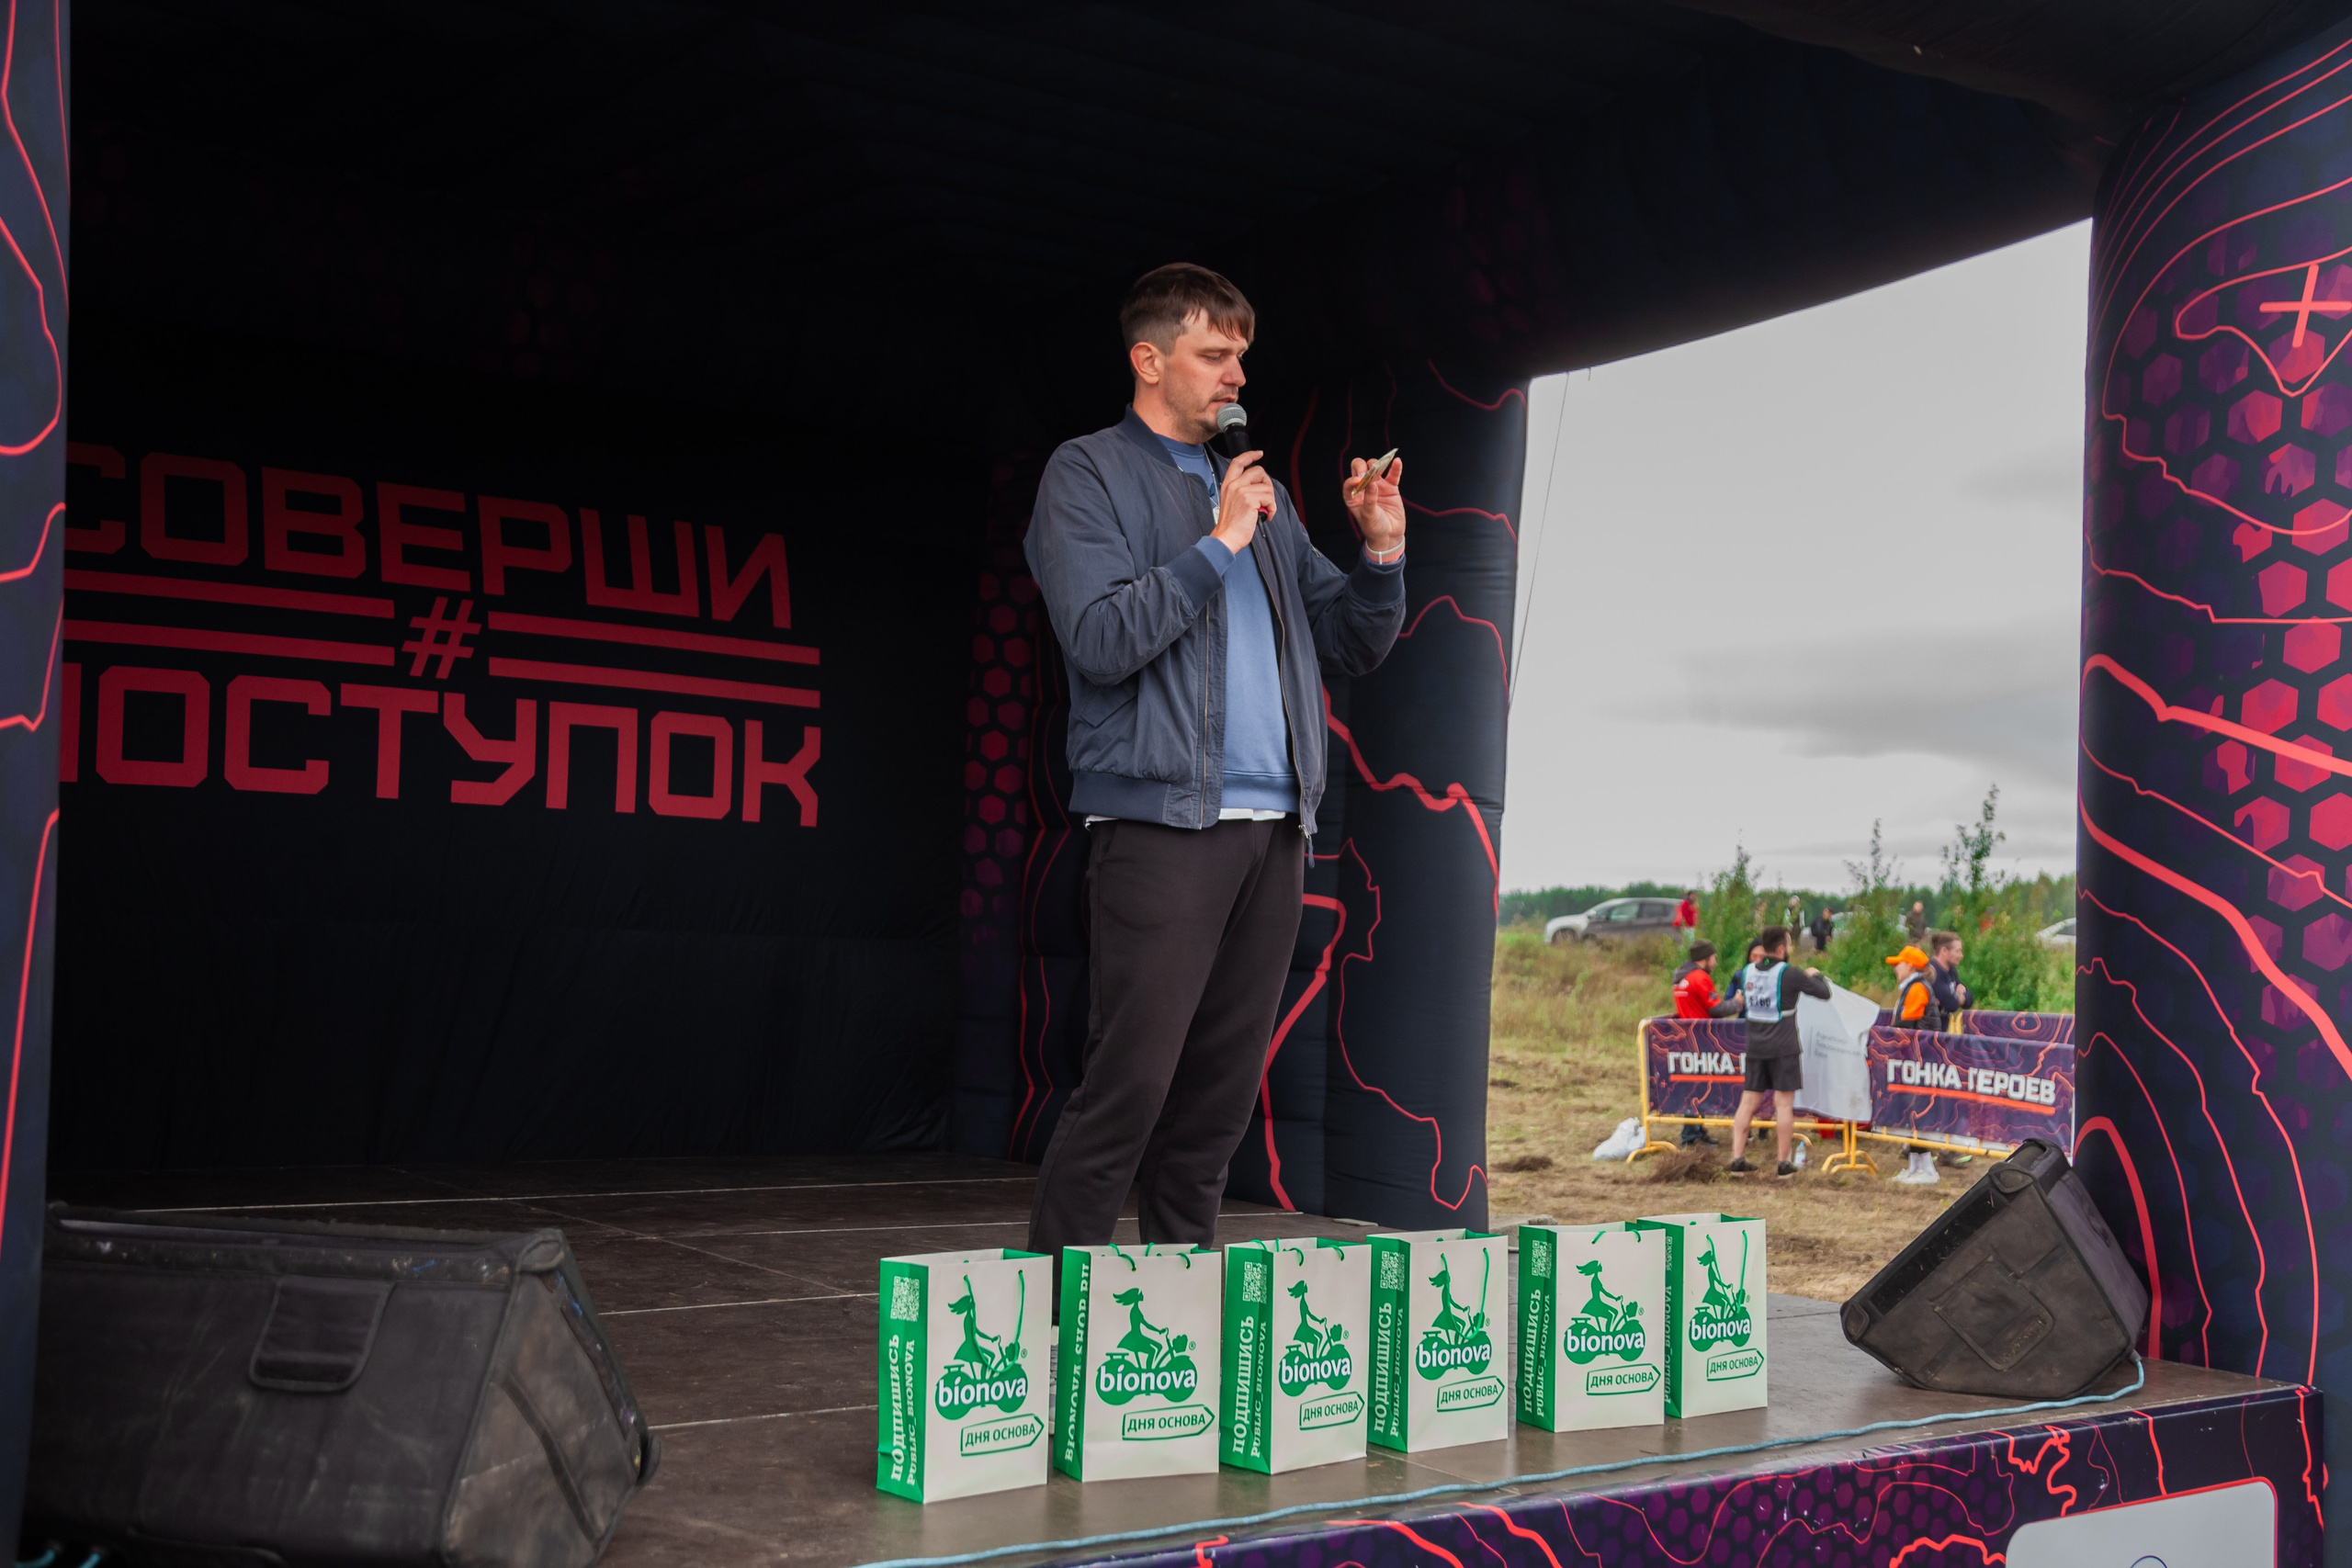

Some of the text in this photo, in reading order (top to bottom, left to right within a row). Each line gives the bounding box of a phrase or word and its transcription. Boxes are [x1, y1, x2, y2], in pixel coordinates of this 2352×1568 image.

[64, 442, 792, 629] СОВЕРШИ
[60, 661, 820, 828] ОСТУПОК
[1668, 1052, 1736, 1075] ГОНКА
[1886, 1059, 2056, 1106] ГОНКА ГЕРОЕВ
[1566, 1327, 1645, 1352] bionova
[1690, 1316, 1751, 1341] bionova
[1419, 1341, 1490, 1369] bionova
[1523, 1289, 1541, 1414] ПОДПИШИСЬ
[1536, 1294, 1550, 1417] PUBLIC_BIONOVA
[1710, 1356, 1758, 1374] ДНЯ ОСНОВА
[1100, 1364, 1196, 1392] bionova
[1281, 1356, 1351, 1385] bionova
[1374, 1302, 1392, 1433] ПОДПИШИСЬ
[1389, 1308, 1403, 1438] PUBLIC_BIONOVA
[1590, 1371, 1654, 1388] ДНЯ ОСНОВА
[938, 1376, 1027, 1407] bionova
[1233, 1315, 1254, 1454] ПОДПИШИСЬ
[1250, 1321, 1267, 1458] PUBLIC_BIONOVA
[1441, 1384, 1498, 1404] ДНЯ ОСНОВА
[888, 1335, 905, 1482] ПОДПИШИСЬ
[905, 1340, 917, 1485] PUBLIC_BIONOVA
[1127, 1414, 1205, 1432] ДНЯ ОСНОВА
[1303, 1400, 1359, 1422] ДНЯ ОСНОВА
[965, 1423, 1036, 1448] ДНЯ ОСНОВА
